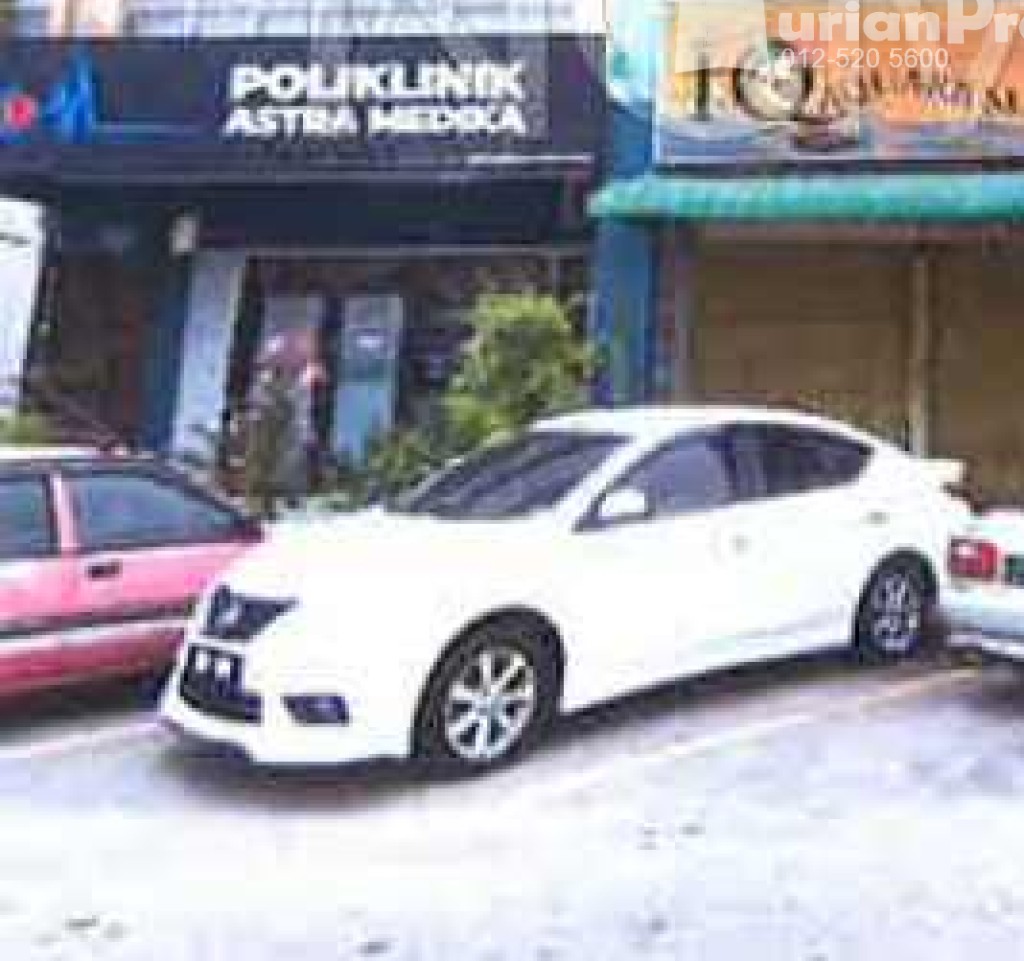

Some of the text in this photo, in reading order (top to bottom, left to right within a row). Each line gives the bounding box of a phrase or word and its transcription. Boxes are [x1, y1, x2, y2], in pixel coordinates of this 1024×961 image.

[230, 63, 525, 100] POLIKLINIK
[224, 105, 527, 135] ASTRA MEDIKA
